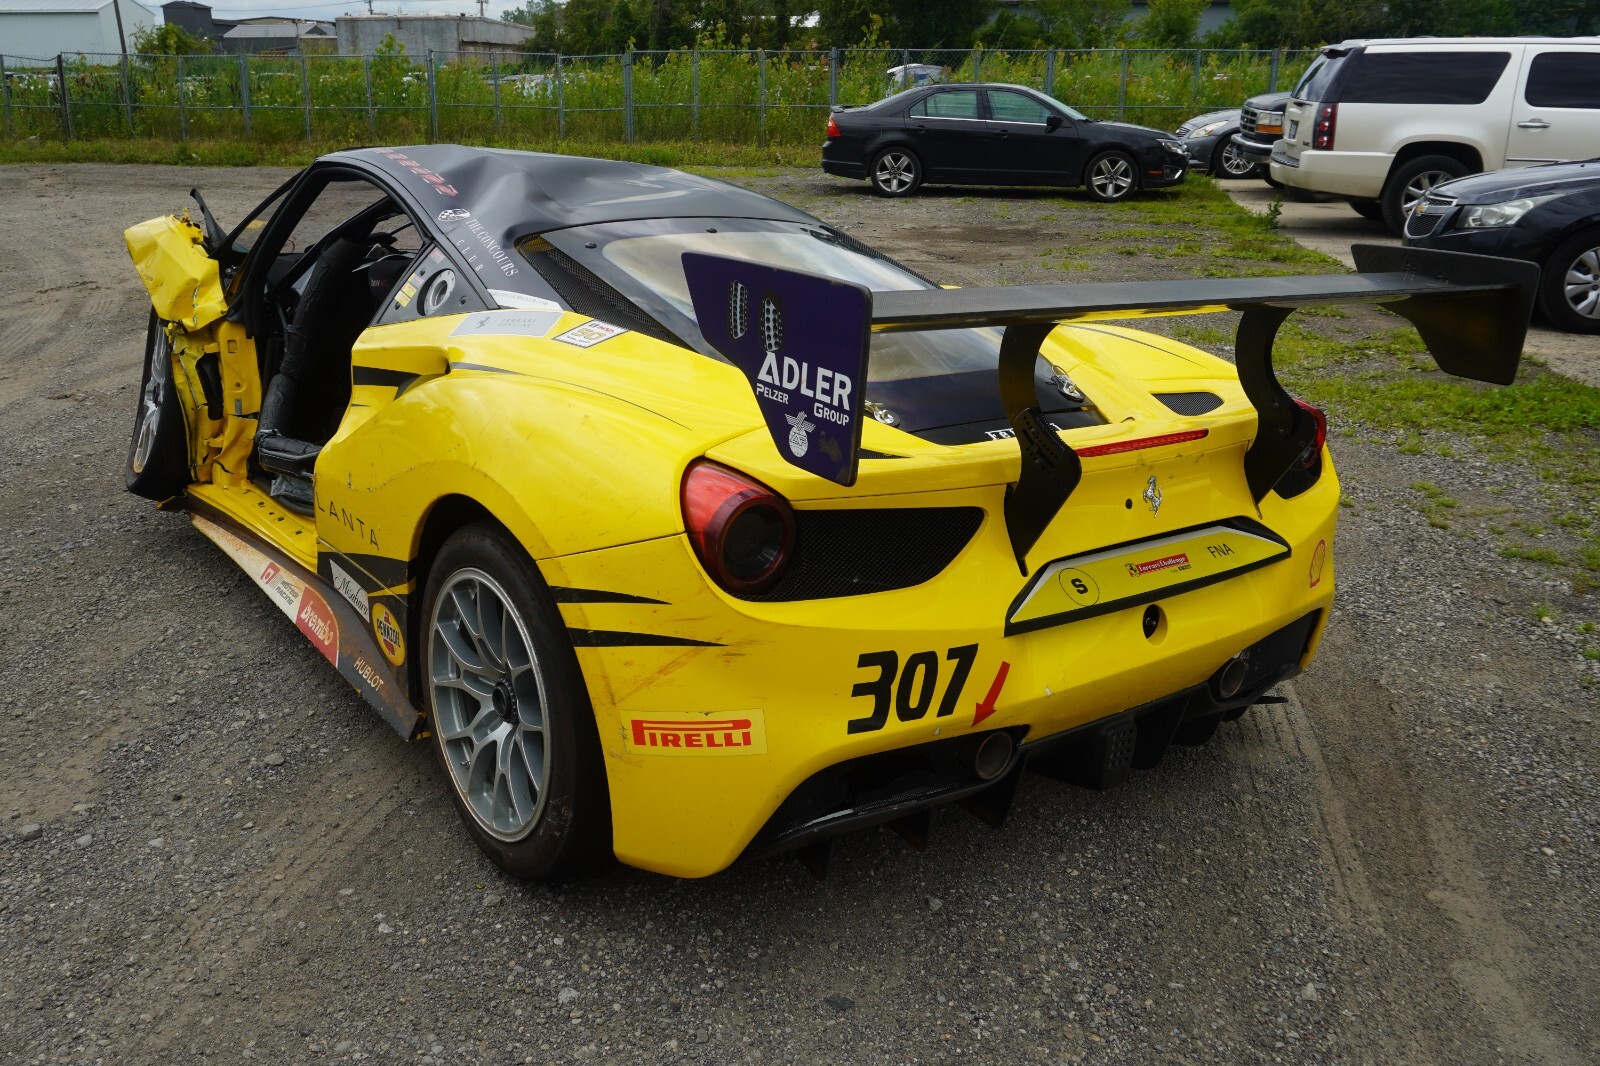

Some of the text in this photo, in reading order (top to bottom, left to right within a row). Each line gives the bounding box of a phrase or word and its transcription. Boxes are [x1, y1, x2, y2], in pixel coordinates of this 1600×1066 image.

[756, 383, 789, 405] PELZER
[757, 350, 852, 411] ADLER
[813, 402, 850, 426] GROUP
[1138, 562, 1160, 572] Ferrari
[1160, 556, 1186, 567] Challenge
[1207, 543, 1235, 559] FNA
[275, 586, 294, 605] RACING
[1070, 578, 1089, 595] S
[300, 601, 334, 646] brembo
[376, 618, 401, 648] PENNZOIL
[353, 656, 385, 692] HUBLOT
[847, 643, 979, 735] 307
[631, 718, 752, 748] PIRELLI
